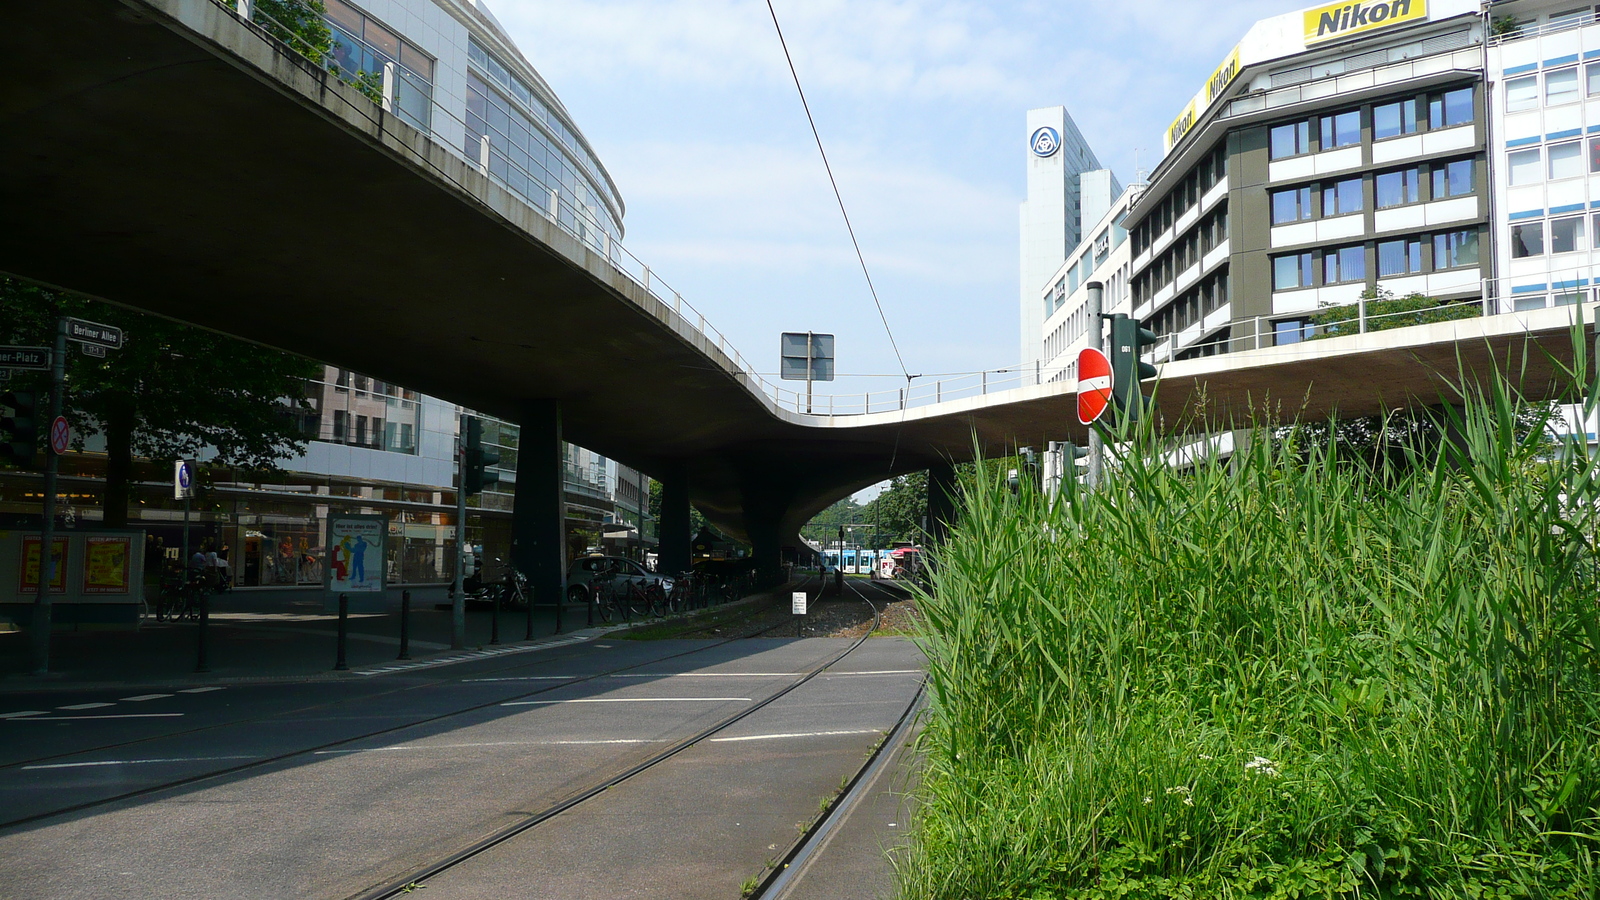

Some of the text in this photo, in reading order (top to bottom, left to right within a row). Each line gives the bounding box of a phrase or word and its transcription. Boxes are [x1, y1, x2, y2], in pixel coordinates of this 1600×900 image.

[1316, 0, 1411, 36] Nikon
[1210, 59, 1235, 102] Nikon
[1171, 110, 1192, 147] Nikon
[74, 324, 117, 342] Berliner Allee
